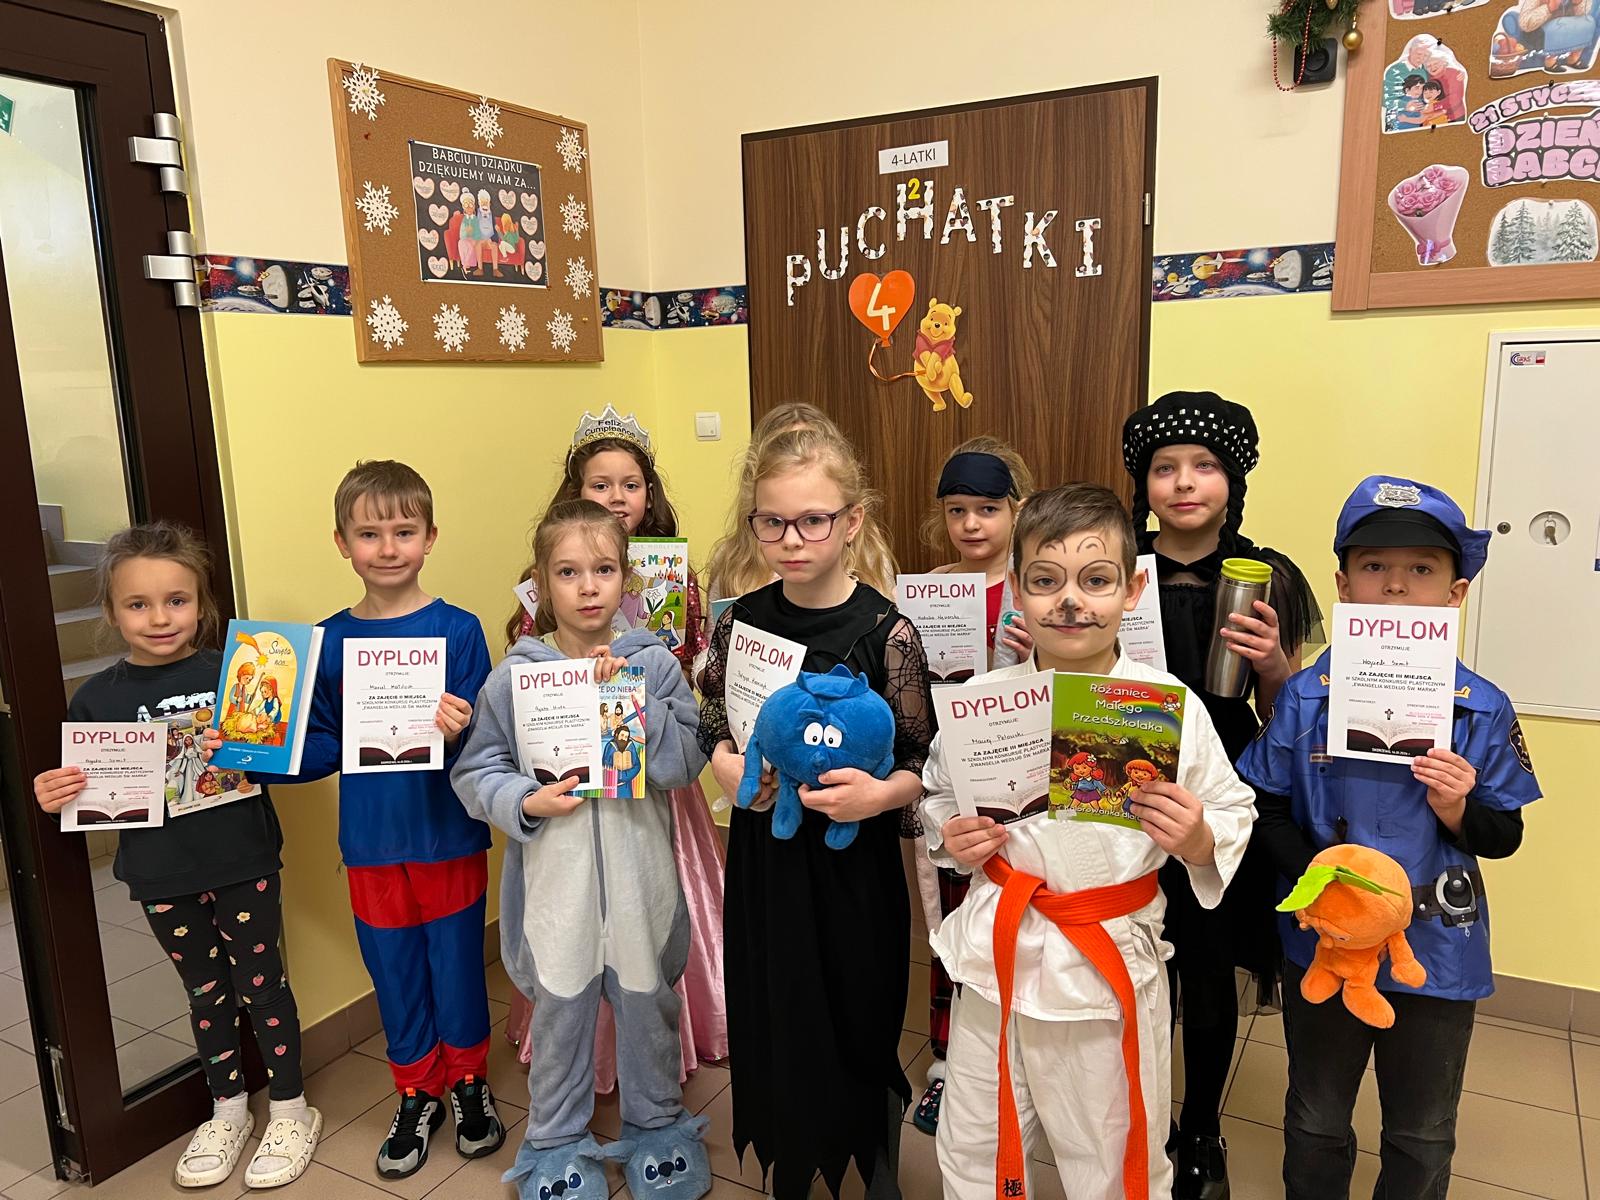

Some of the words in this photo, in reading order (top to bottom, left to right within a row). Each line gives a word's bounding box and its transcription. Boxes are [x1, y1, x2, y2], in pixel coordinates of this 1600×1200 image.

[1469, 104, 1500, 132] 21
[432, 147, 471, 165] BABCIU
[474, 156, 478, 167] I
[481, 157, 523, 174] DZIADKU
[890, 147, 937, 167] 4-LATKI
[418, 160, 484, 182] DZIĘKUJEMY
[487, 172, 512, 186] WAM
[514, 177, 537, 190] ZA...
[865, 282, 896, 331] 4
[597, 419, 622, 427] Feliz
[647, 553, 683, 568] Maryjo
[906, 583, 976, 599] DYPLOM
[1348, 618, 1449, 641] DYPLOM
[358, 649, 438, 666] DYPLOM
[735, 634, 794, 671] DYPLOM
[519, 669, 589, 690] DYPLOM
[617, 685, 637, 693] NIEBA
[1089, 683, 1151, 699] Różaniec
[951, 684, 1051, 720] DYPLOM
[1095, 698, 1143, 714] Małego
[1072, 712, 1164, 733] Przedszkolaka
[72, 731, 156, 745] DYPLOM
[982, 747, 1009, 756] ZAJĘCIE
[1017, 738, 1044, 749] MIEJSCA
